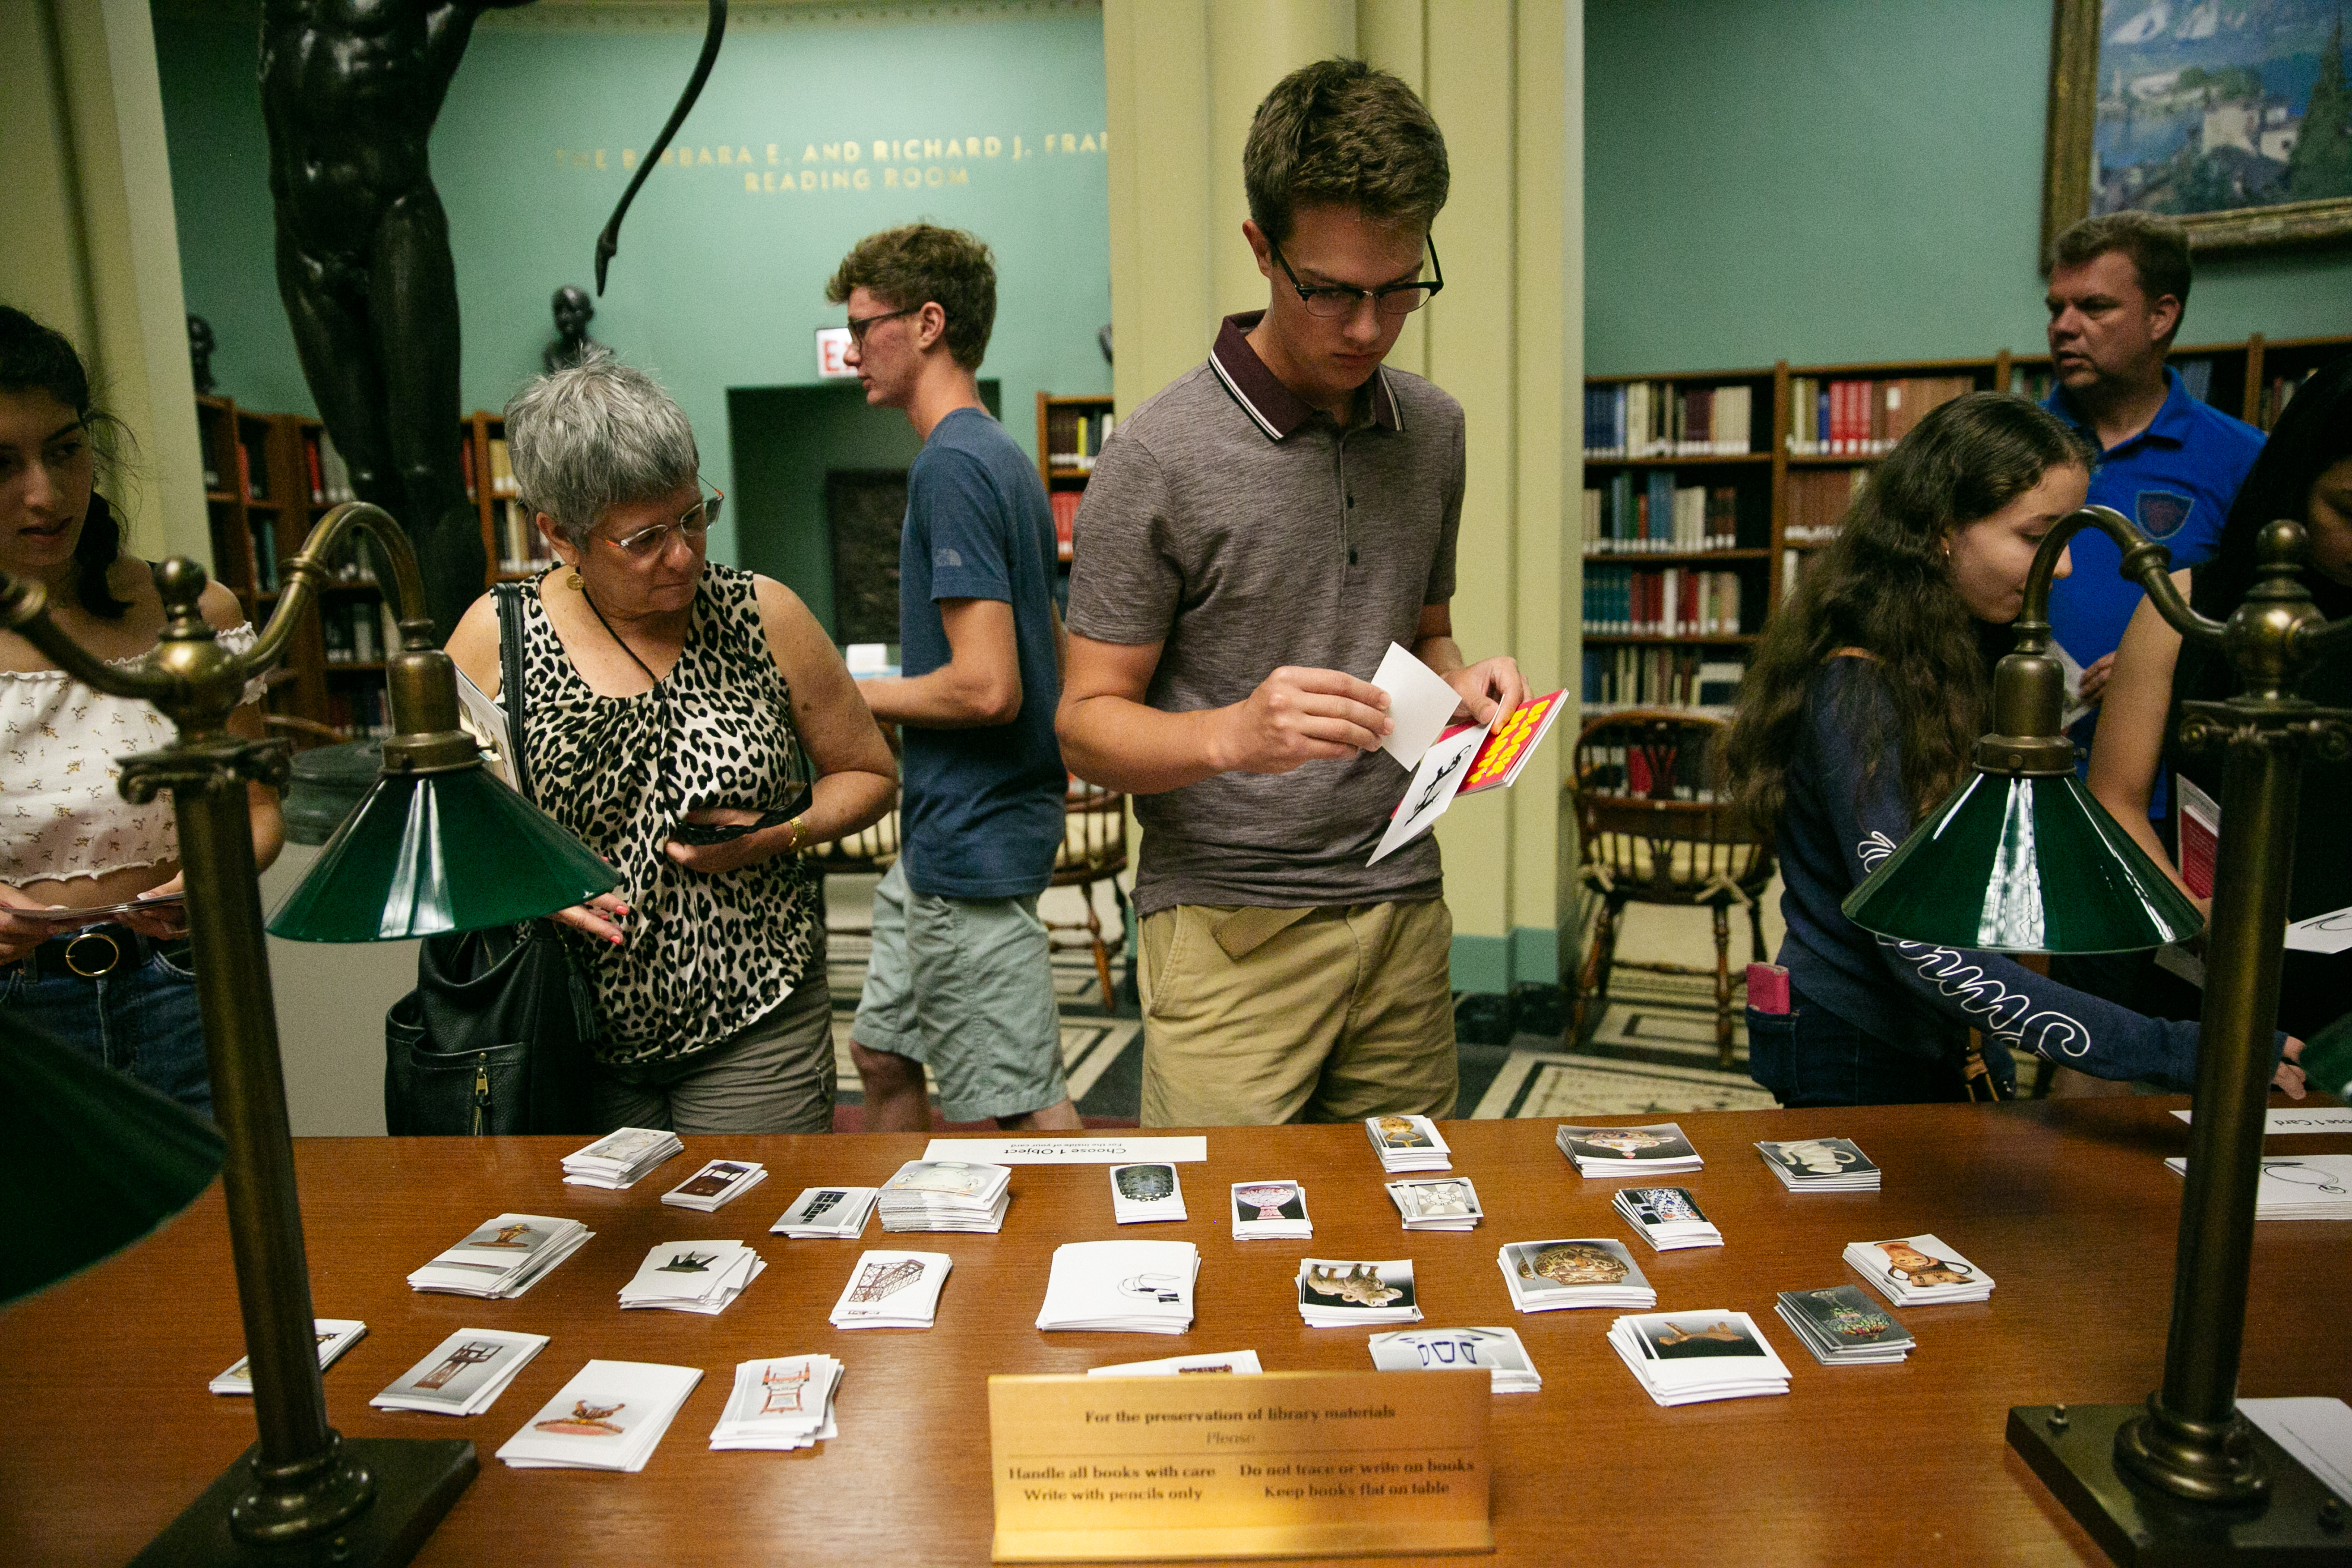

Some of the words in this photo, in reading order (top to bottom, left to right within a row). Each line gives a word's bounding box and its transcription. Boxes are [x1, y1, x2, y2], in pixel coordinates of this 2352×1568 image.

[622, 145, 753, 170] BRBARA
[802, 140, 861, 163] AND
[872, 136, 1002, 162] RICHARD
[745, 167, 871, 192] READING
[884, 166, 969, 189] ROOM
[1086, 1410, 1110, 1424] For
[1116, 1409, 1140, 1423] the
[1145, 1408, 1243, 1425] preservation
[1247, 1407, 1263, 1420] of
[1267, 1406, 1319, 1423] library
[1325, 1404, 1396, 1420] materials
[1207, 1431, 1255, 1444] Please
[1010, 1466, 1066, 1480] Handle
[1070, 1465, 1088, 1479] all
[1093, 1465, 1139, 1478] books
[1146, 1465, 1178, 1478] with
[1183, 1466, 1216, 1478] care
[1240, 1463, 1262, 1477] Do
[1266, 1463, 1291, 1476] not
[1297, 1463, 1334, 1476] trace
[1339, 1465, 1354, 1475] or
[1360, 1461, 1400, 1475] write
[1403, 1463, 1423, 1474] on
[1427, 1459, 1475, 1473] books
[1024, 1488, 1067, 1501] Write
[1071, 1487, 1104, 1501] with
[1109, 1486, 1164, 1503] pencils
[1168, 1486, 1202, 1502] only
[1265, 1485, 1305, 1500] Keep
[1309, 1482, 1355, 1497] books
[1360, 1482, 1384, 1496] flat
[1389, 1484, 1408, 1496] on
[1412, 1480, 1450, 1496] table
